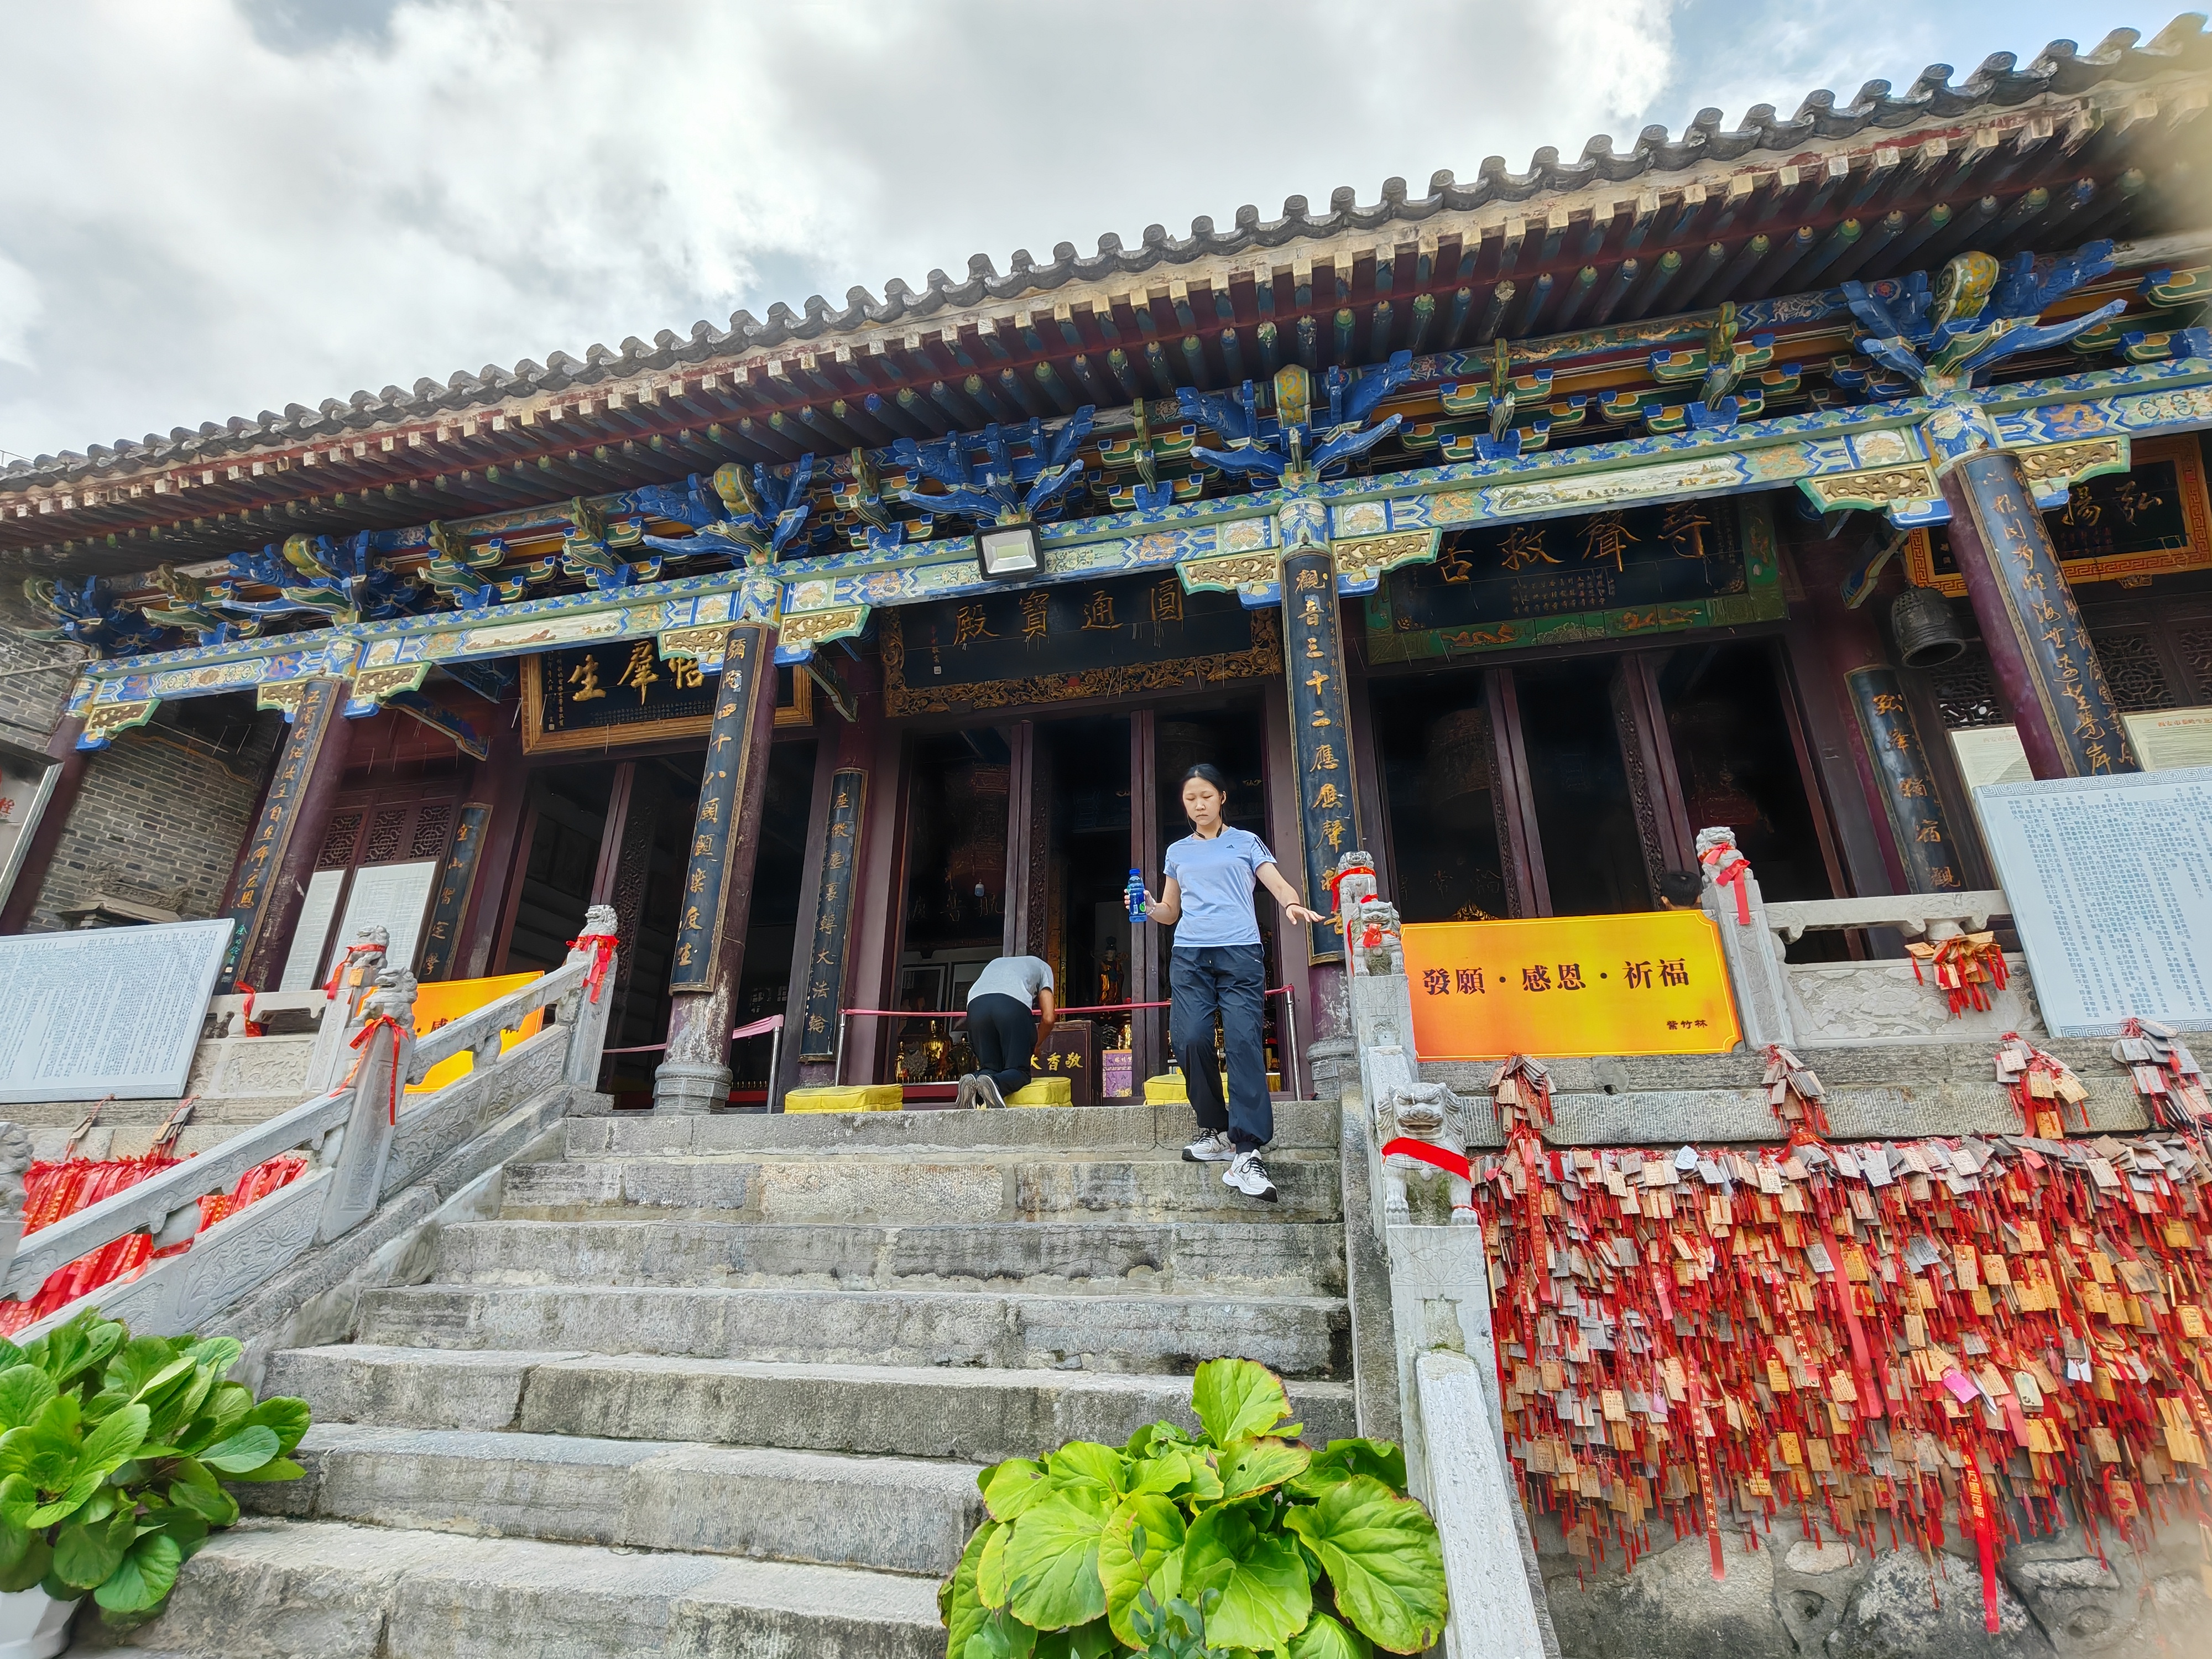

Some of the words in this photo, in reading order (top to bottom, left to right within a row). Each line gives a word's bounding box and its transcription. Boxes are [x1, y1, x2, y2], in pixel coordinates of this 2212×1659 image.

[953, 576, 1186, 646] 圓通寶殿
[1666, 1019, 1708, 1030] 紫竹林
